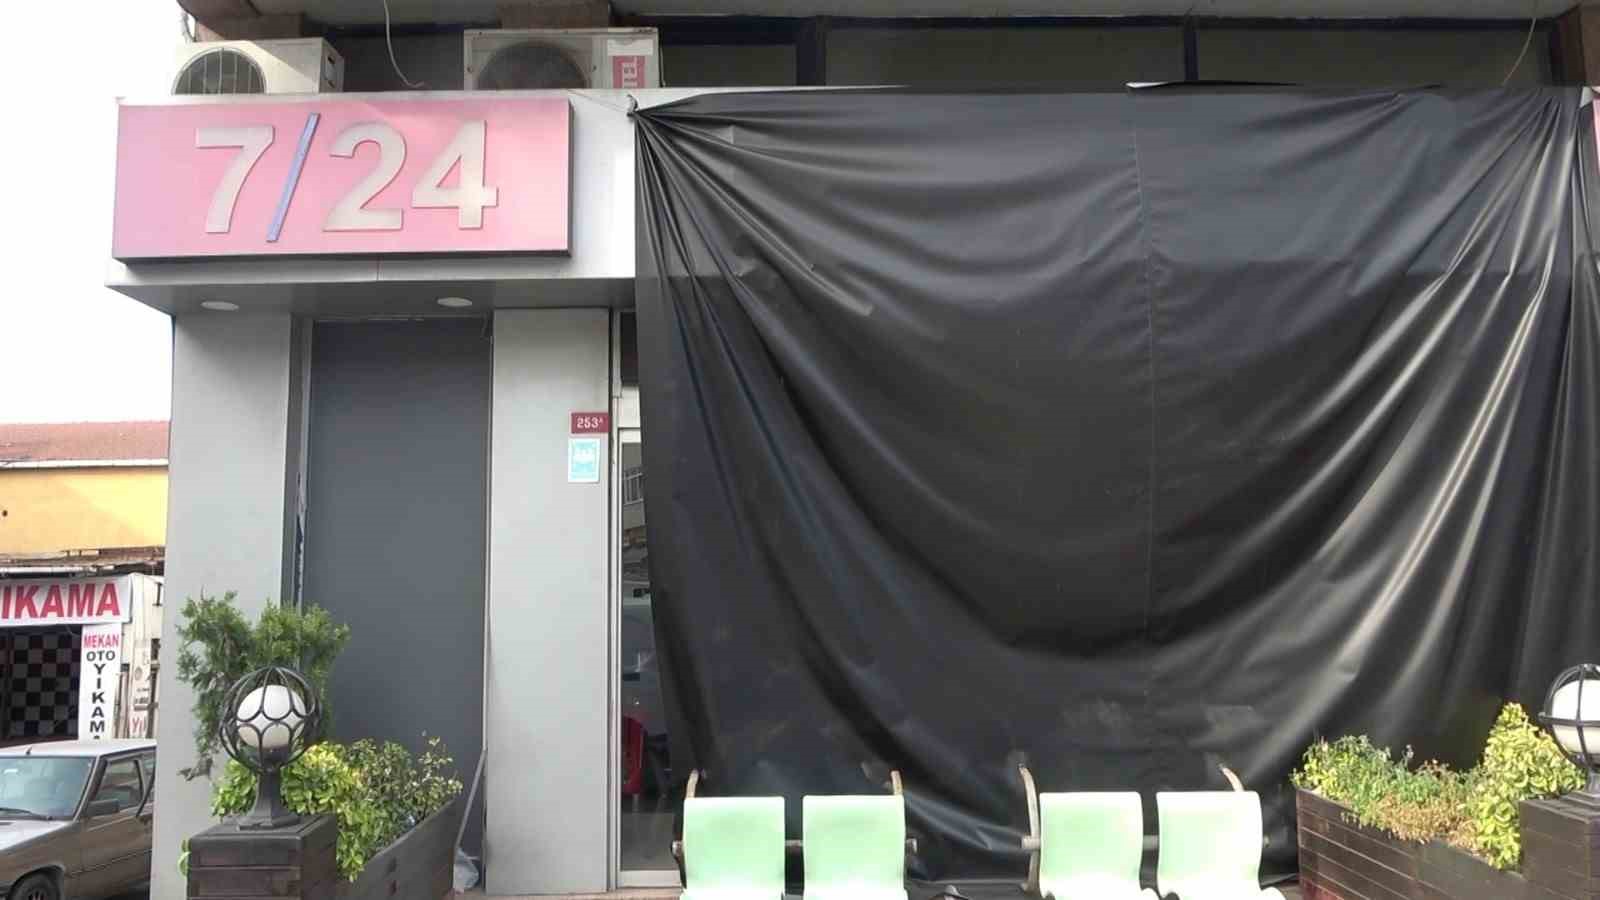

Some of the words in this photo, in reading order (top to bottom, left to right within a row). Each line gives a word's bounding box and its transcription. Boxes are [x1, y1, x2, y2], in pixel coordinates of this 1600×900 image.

[195, 113, 499, 242] 7/24
[1, 583, 120, 619] IKAMA
[84, 634, 119, 648] MEKAN
[86, 650, 116, 662] OTO
[89, 663, 105, 740] YIKAM
